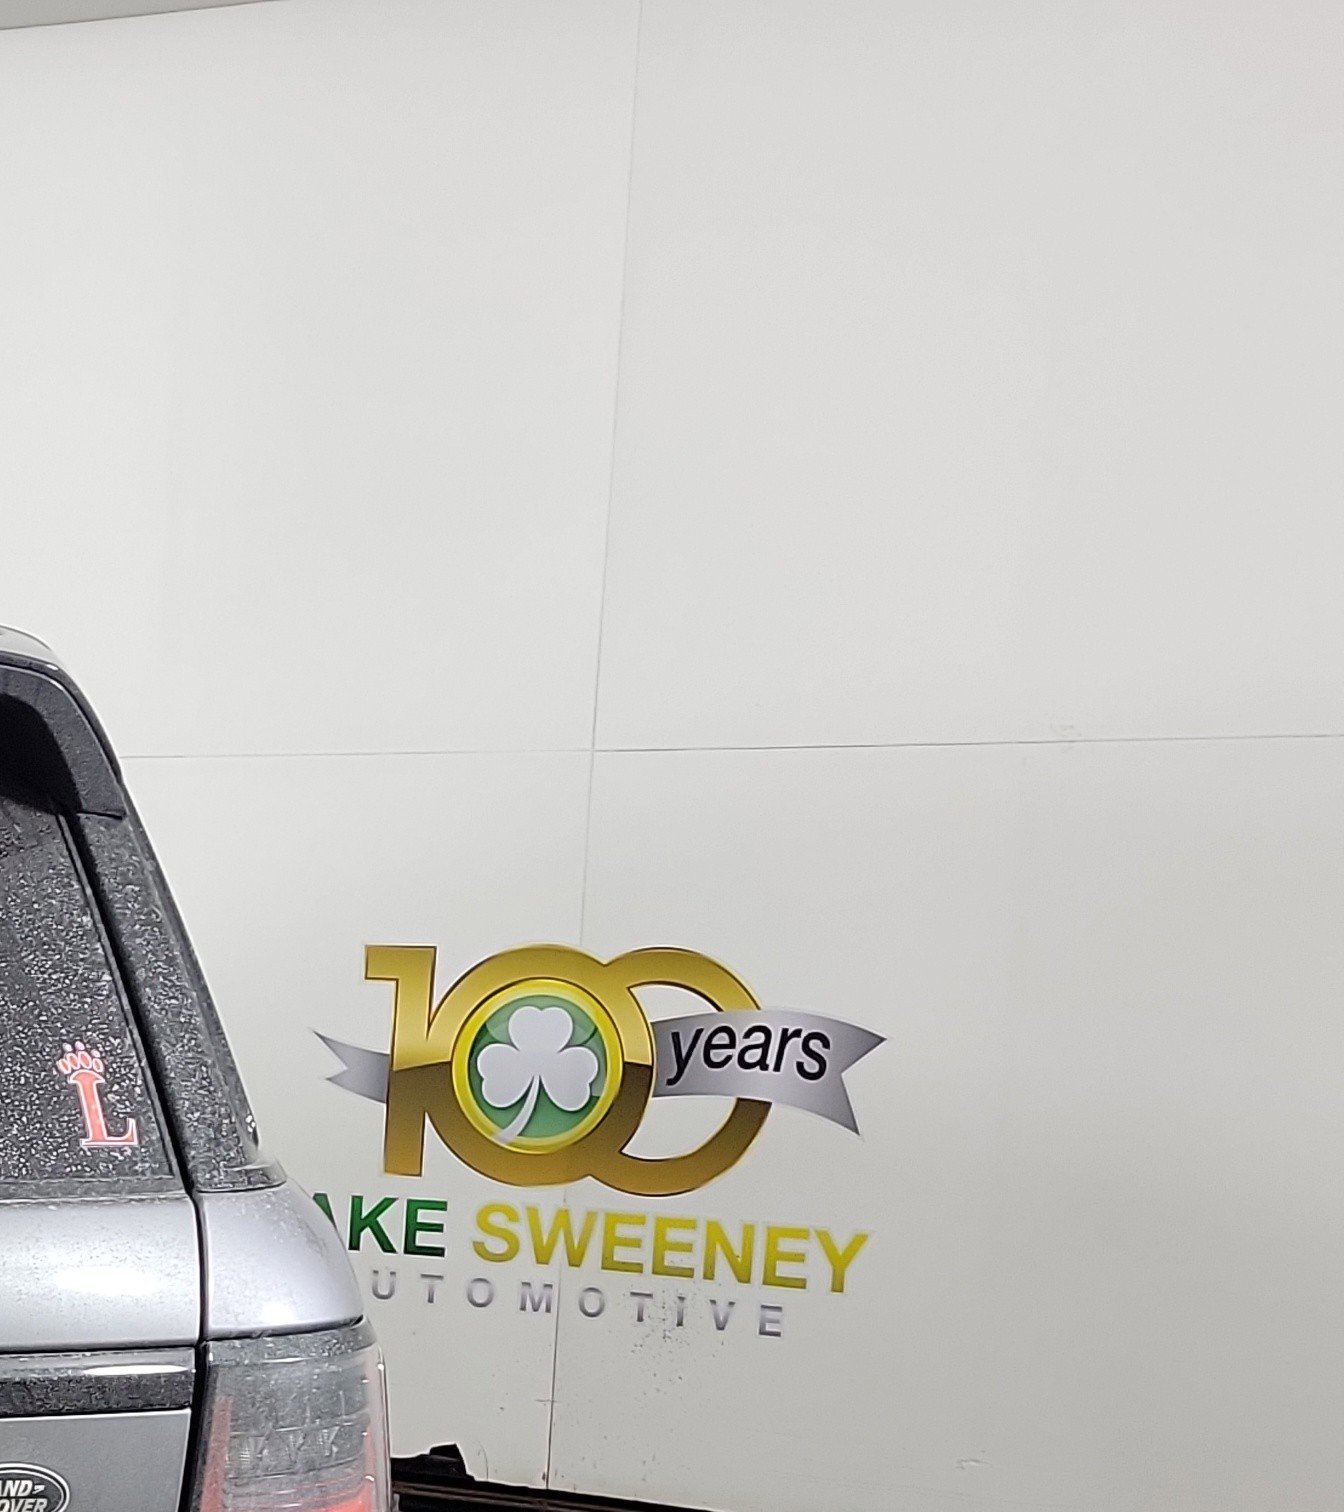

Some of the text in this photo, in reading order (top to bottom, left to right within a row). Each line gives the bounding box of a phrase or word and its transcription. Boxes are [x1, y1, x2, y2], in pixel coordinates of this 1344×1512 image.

[666, 1023, 831, 1086] years
[312, 1192, 869, 1293] KE SWEENEY
[371, 1268, 784, 1337] UTOMOTIVE
